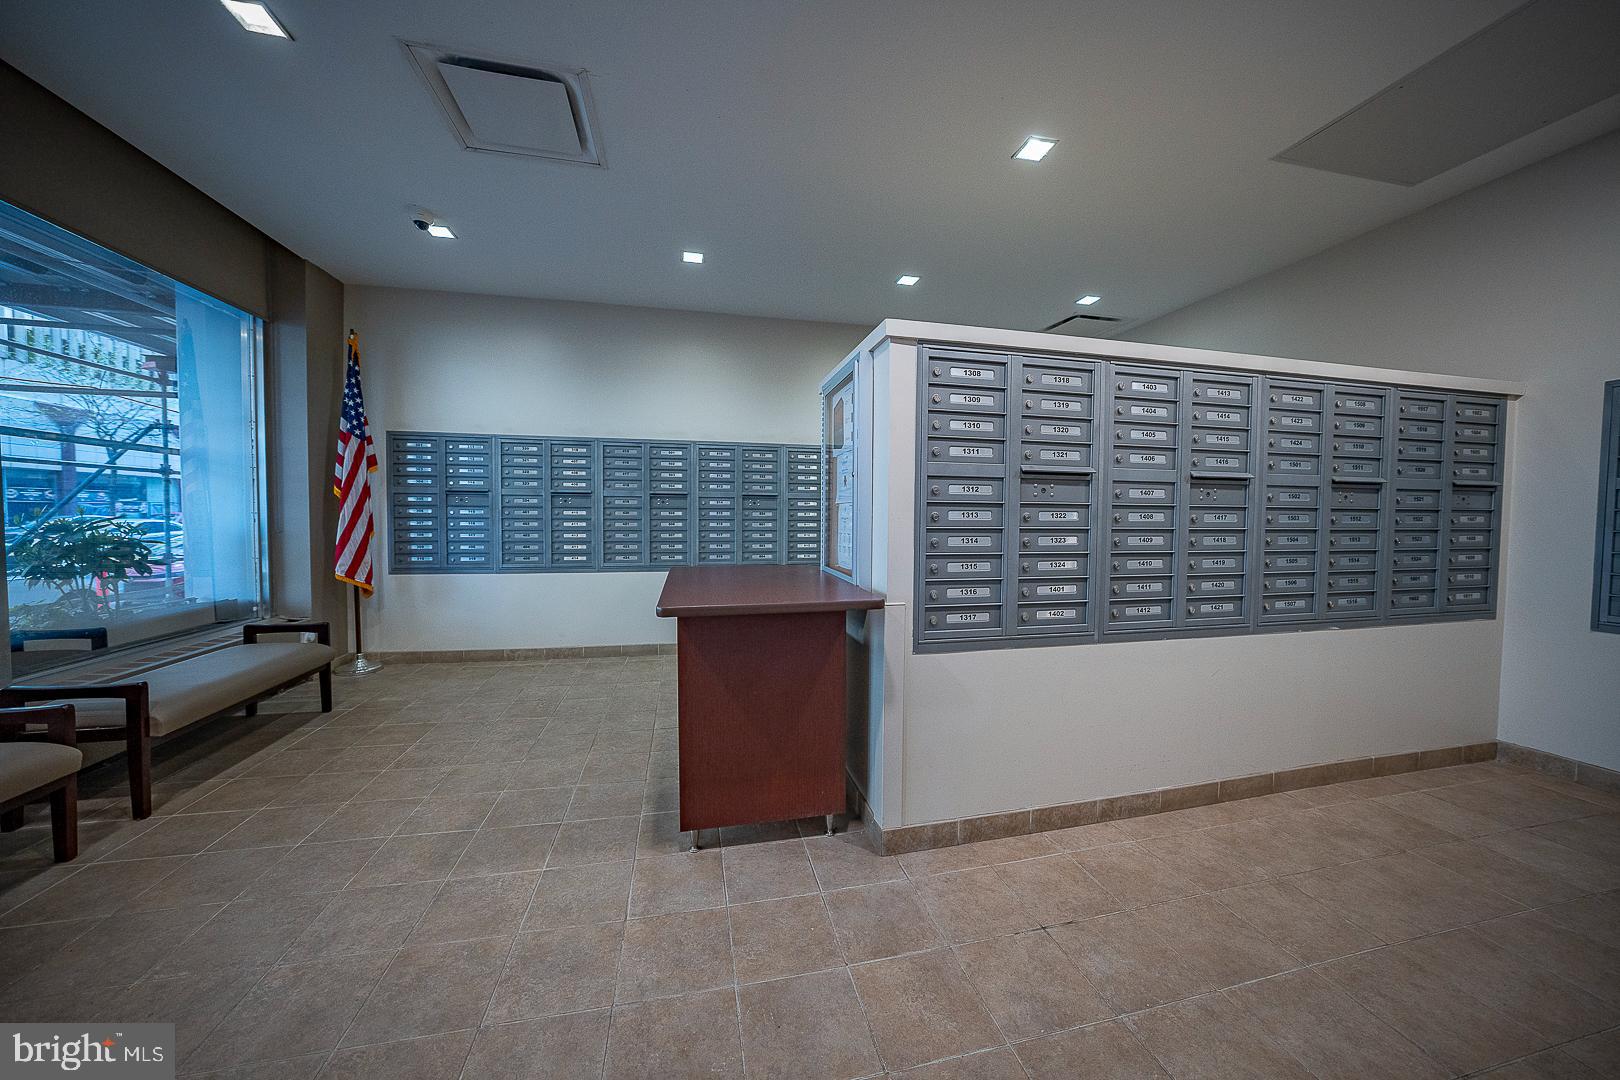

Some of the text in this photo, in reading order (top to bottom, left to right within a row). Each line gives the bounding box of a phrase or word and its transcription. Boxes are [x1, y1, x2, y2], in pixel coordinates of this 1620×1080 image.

[963, 369, 981, 377] 1308
[1053, 376, 1070, 384] 1318
[1142, 383, 1157, 391] 1403
[1217, 389, 1231, 397] 1413
[963, 395, 981, 403] 1309
[1291, 395, 1304, 403] 1422
[1053, 401, 1069, 409] 1319
[1217, 412, 1230, 420] 1414
[1053, 426, 1069, 434] 1320
[1216, 435, 1230, 443] 1415
[962, 447, 980, 455] 1311
[1141, 454, 1155, 462] 1406
[962, 485, 980, 493] 1312
[1140, 489, 1154, 497] 1407
[1051, 511, 1067, 519] 1322
[1139, 512, 1154, 520] 1408
[1214, 513, 1227, 521] 1417
[960, 536, 978, 544] 1314
[1050, 536, 1066, 544] 1323
[1138, 536, 1153, 544] 1409
[1213, 536, 1227, 544] 1418
[960, 562, 978, 570] 1315
[1138, 559, 1152, 567] 1410
[960, 587, 978, 595] 1316
[1049, 585, 1065, 593] 1401
[1210, 603, 1224, 611] 1421
[959, 613, 977, 621] 1317
